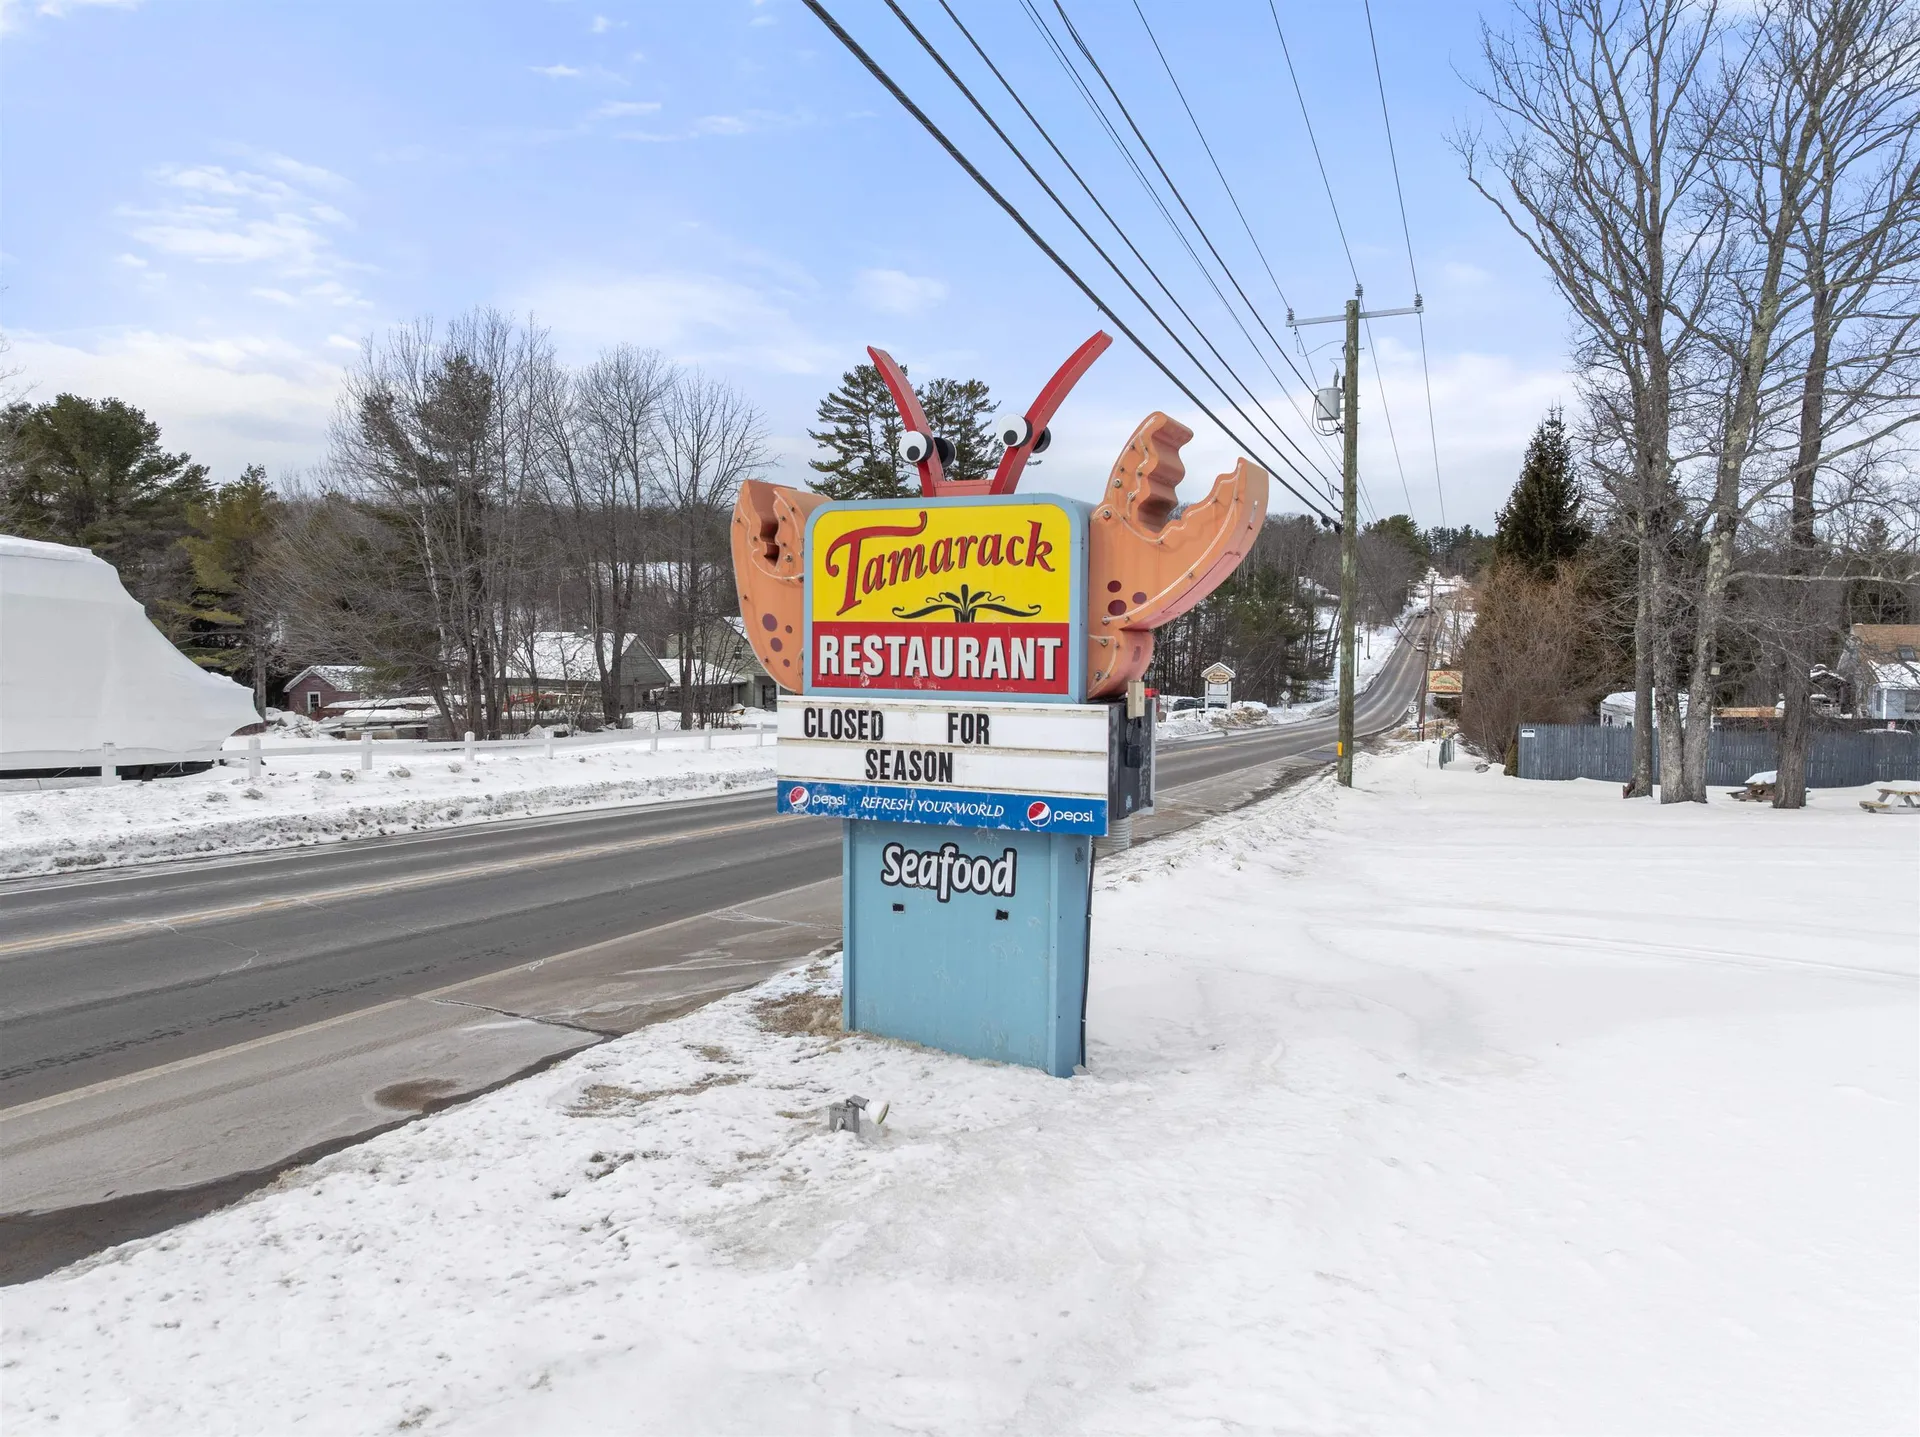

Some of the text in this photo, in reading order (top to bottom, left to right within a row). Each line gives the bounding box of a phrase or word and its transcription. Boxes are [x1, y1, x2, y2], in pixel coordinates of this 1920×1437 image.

[825, 510, 1056, 616] Tamarack
[819, 635, 1062, 681] RESTAURANT
[804, 707, 990, 745] CLOSED FOR
[865, 749, 953, 783] SEASON
[812, 794, 846, 807] pepsi
[860, 796, 1004, 817] REFRESH YOUR WORLD
[1053, 810, 1095, 824] pepsi
[880, 841, 1018, 904] Seafood
